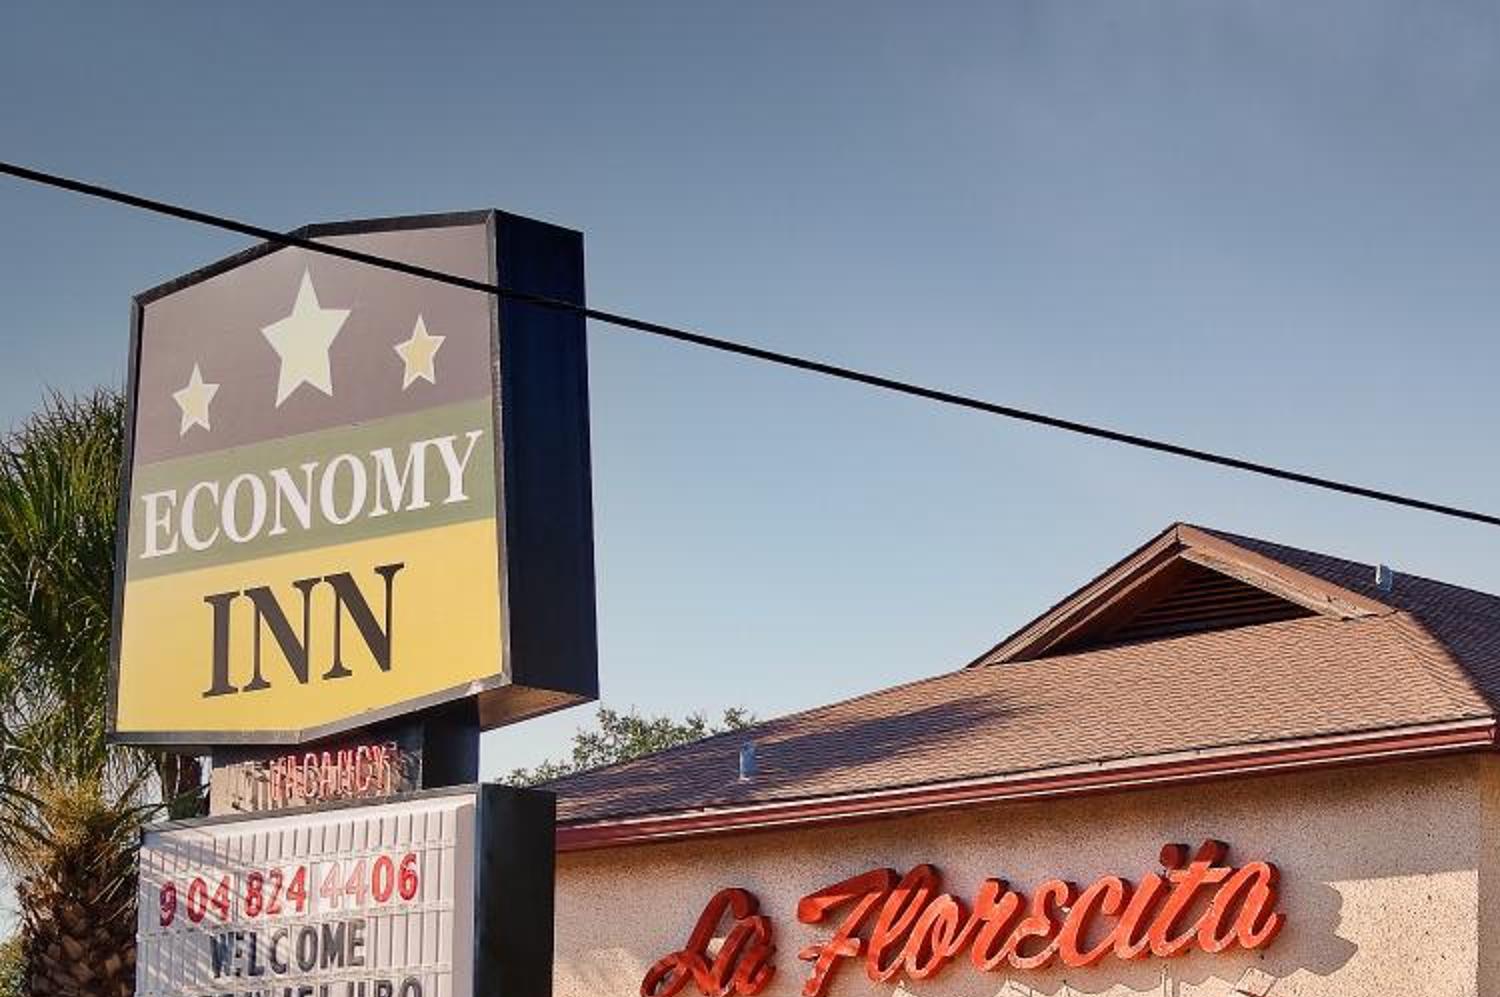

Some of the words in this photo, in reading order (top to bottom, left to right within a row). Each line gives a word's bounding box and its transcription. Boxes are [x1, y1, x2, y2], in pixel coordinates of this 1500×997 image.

[139, 429, 484, 559] ECONOMY
[202, 562, 405, 698] INN
[159, 865, 231, 927] 904
[244, 865, 307, 918] 824
[319, 853, 419, 908] 4406
[210, 919, 366, 978] WELCOME
